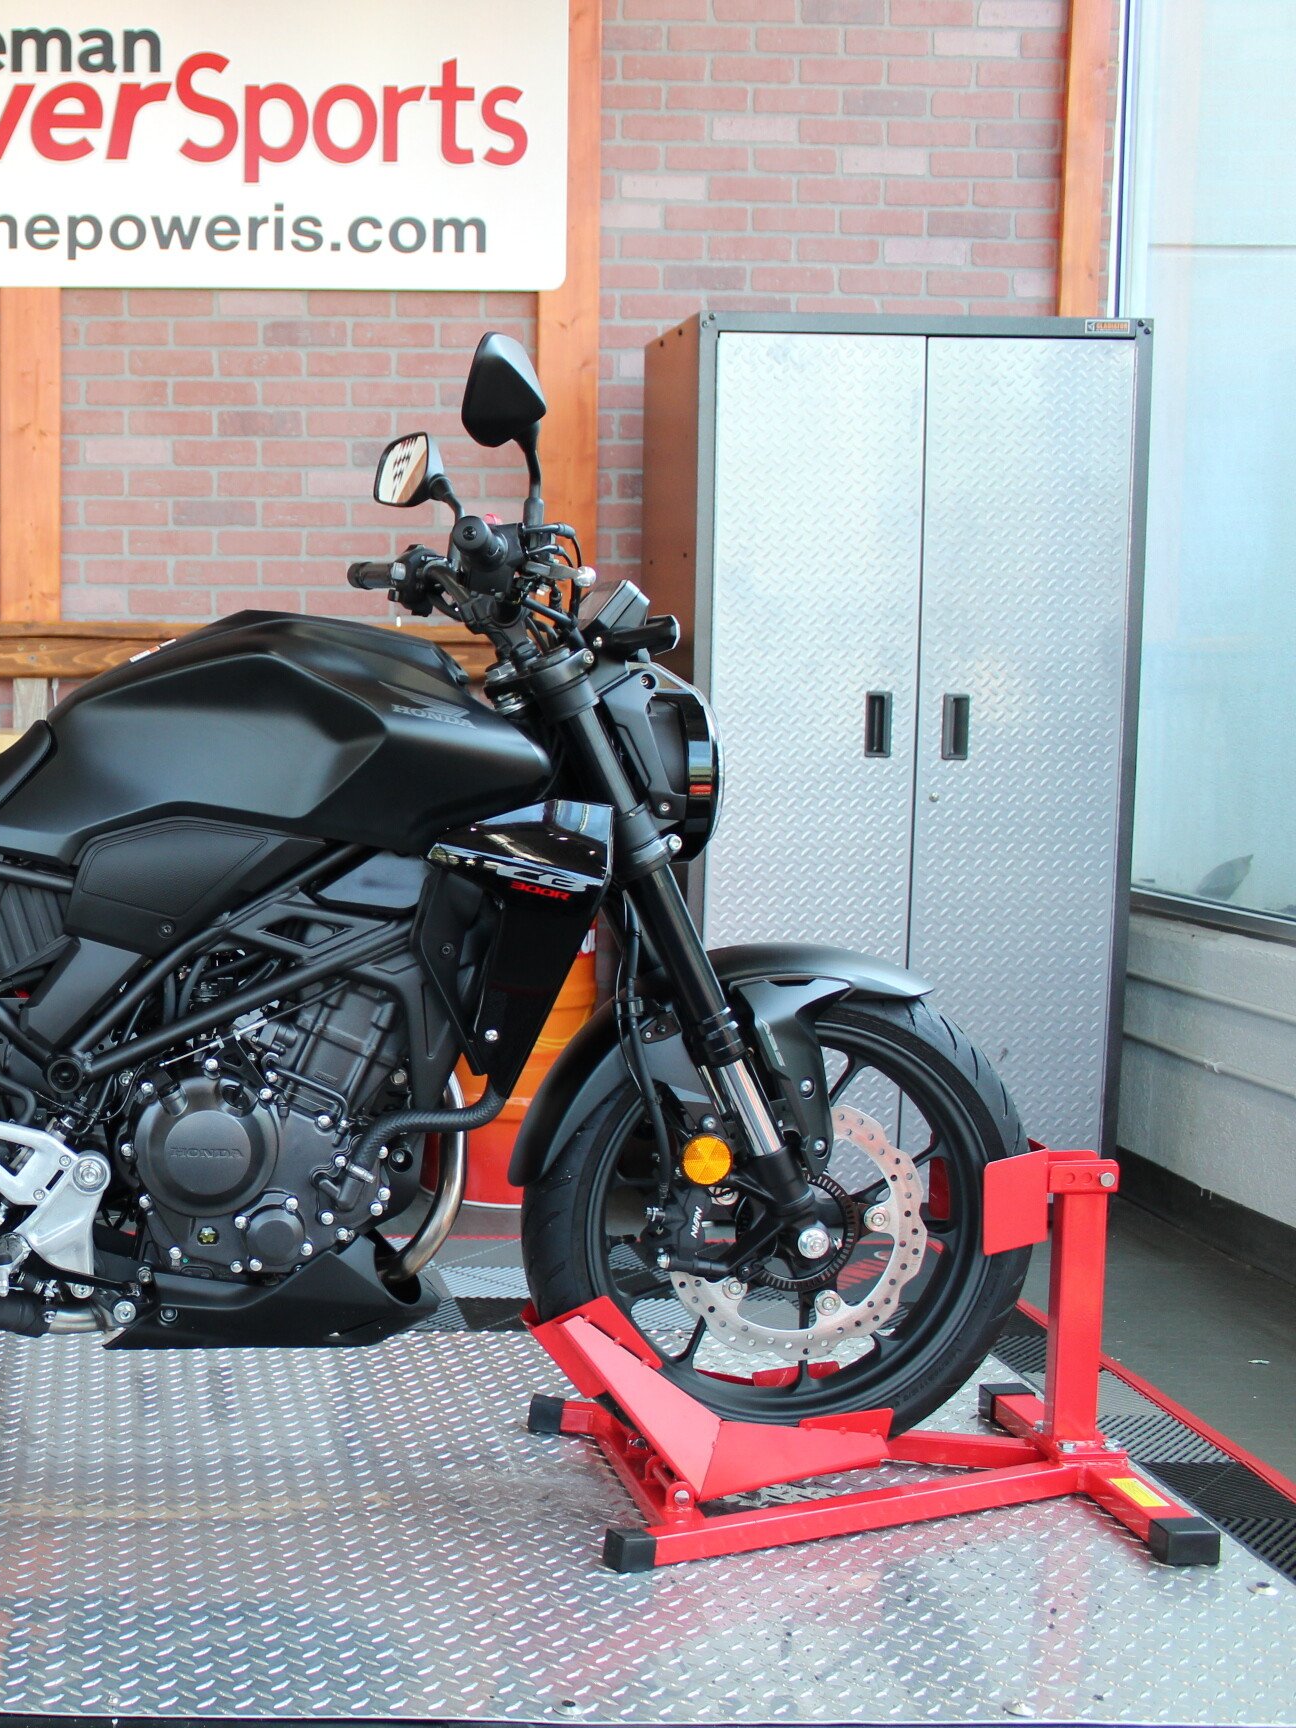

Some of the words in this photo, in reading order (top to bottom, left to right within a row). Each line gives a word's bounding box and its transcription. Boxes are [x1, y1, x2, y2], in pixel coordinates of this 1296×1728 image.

[391, 703, 478, 730] HONDA
[496, 864, 588, 893] CB
[510, 881, 572, 901] 300R
[170, 1147, 244, 1158] HONDA
